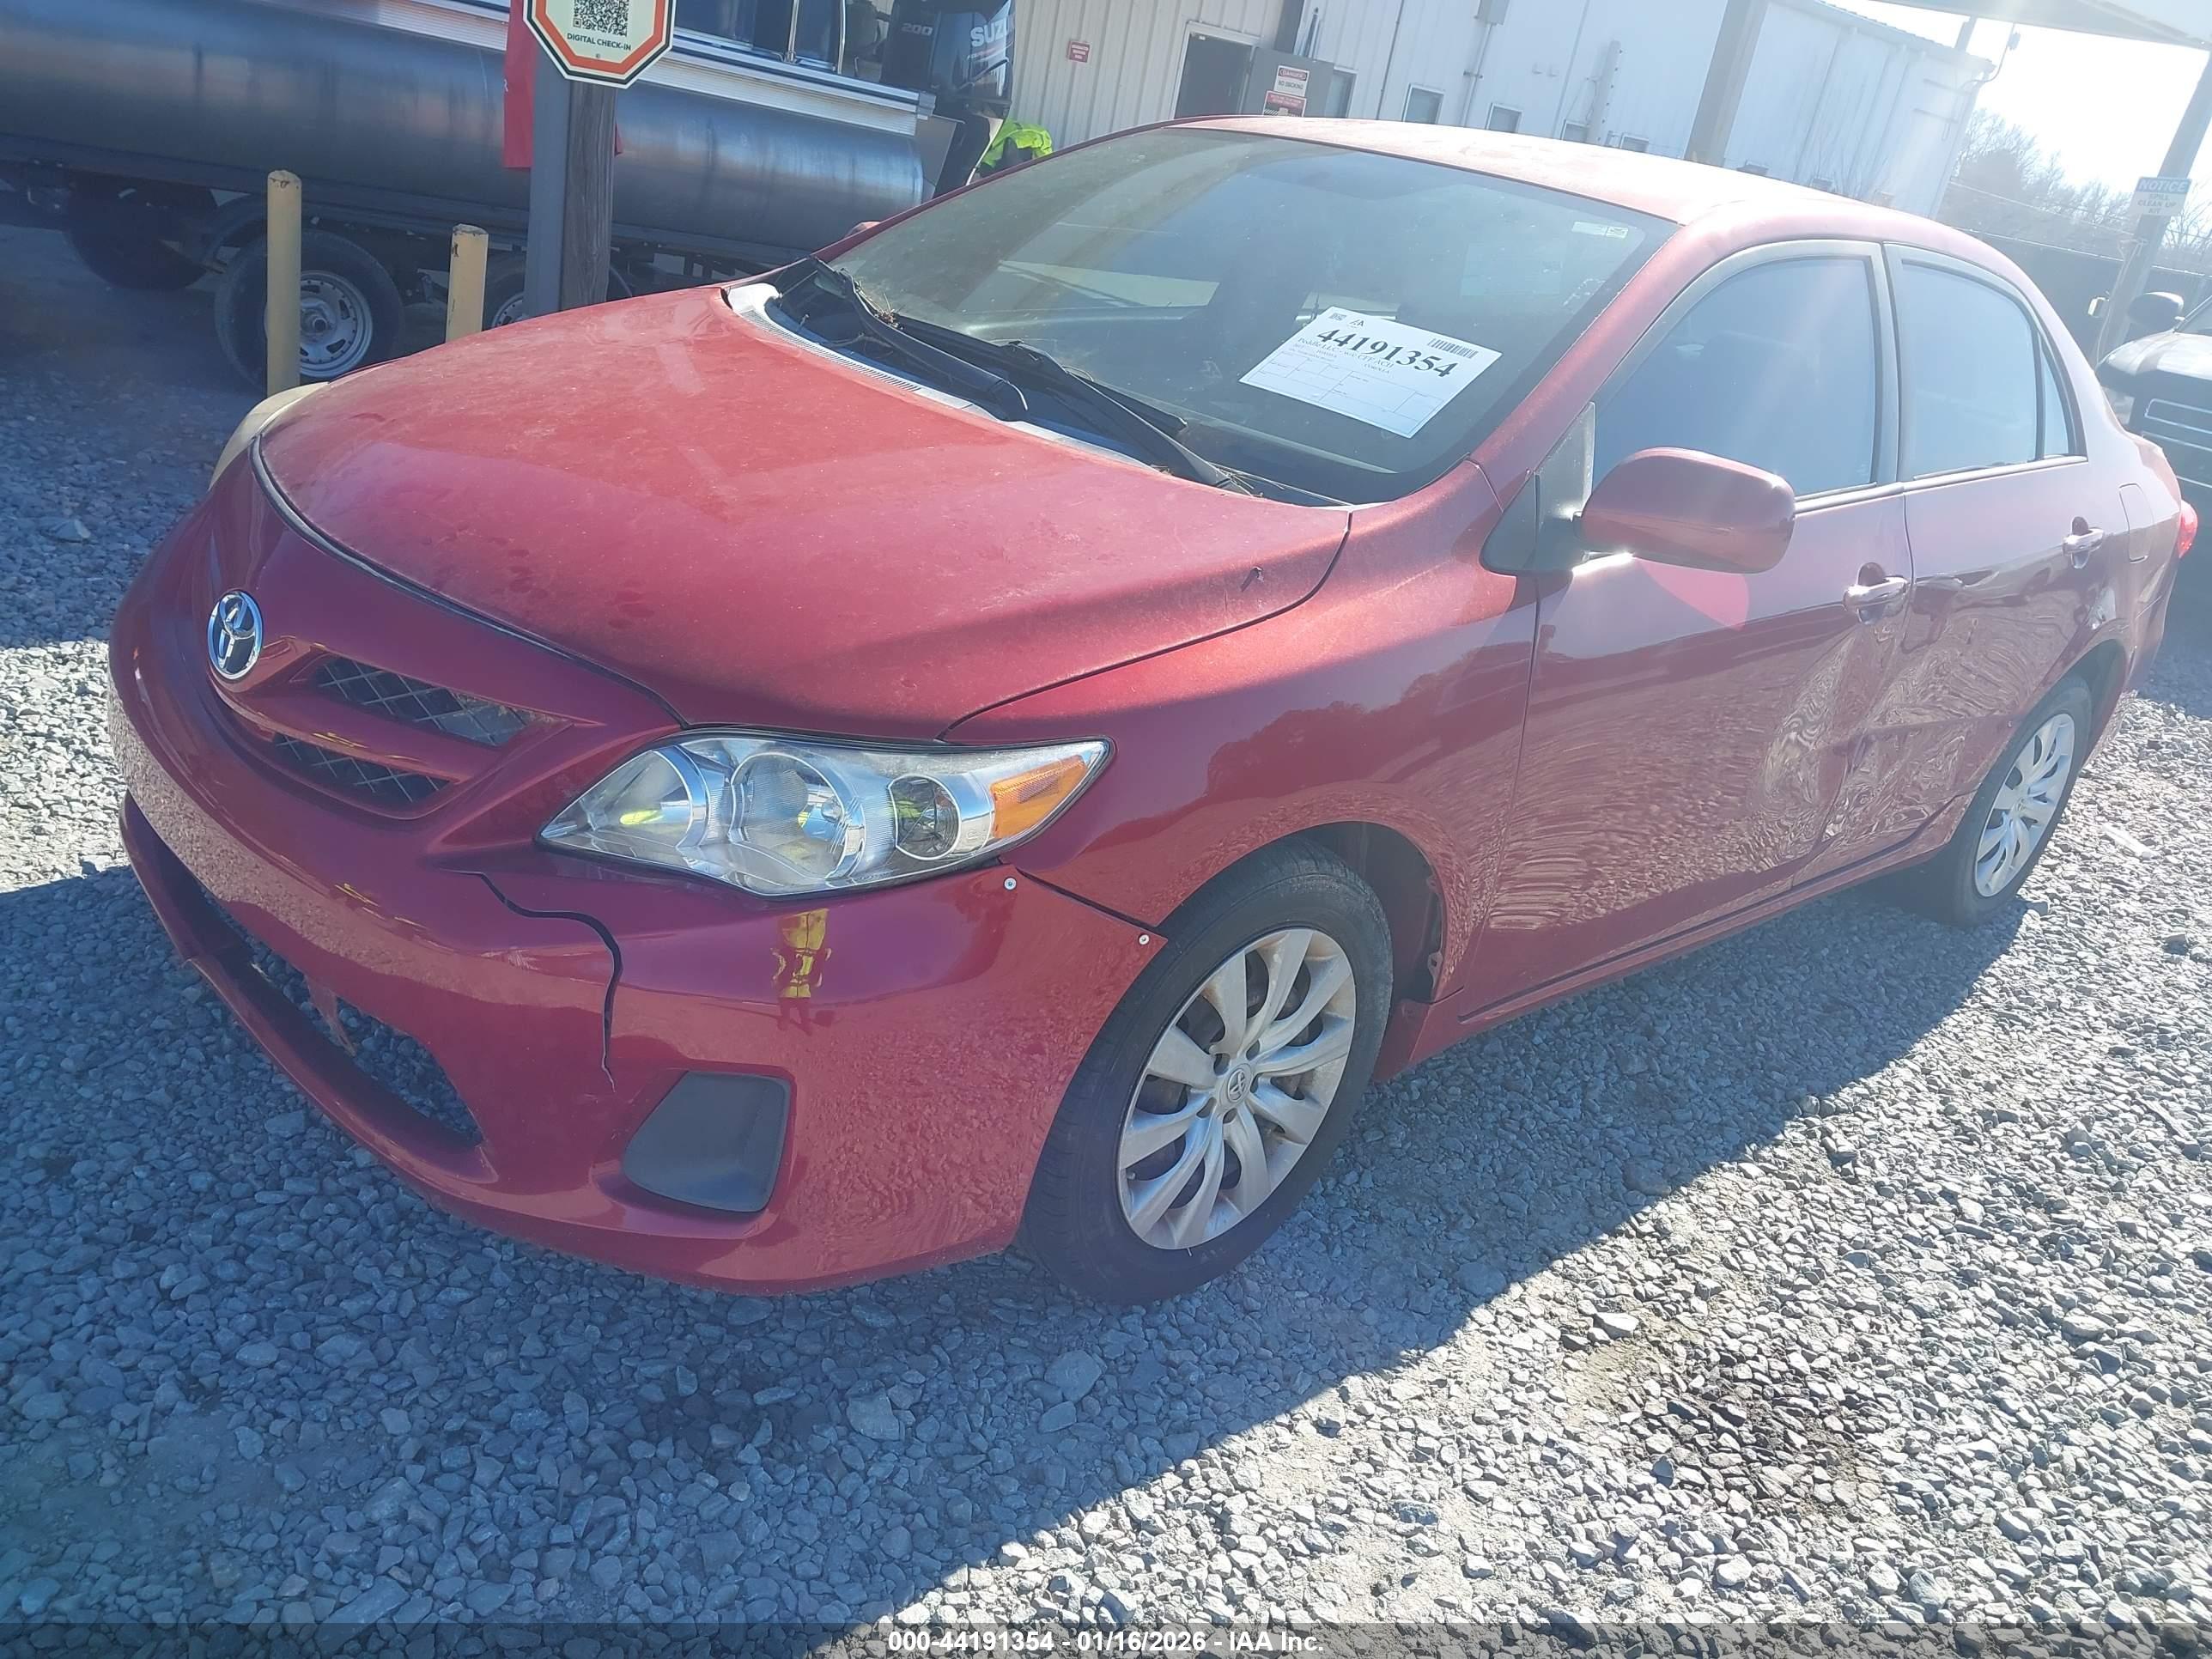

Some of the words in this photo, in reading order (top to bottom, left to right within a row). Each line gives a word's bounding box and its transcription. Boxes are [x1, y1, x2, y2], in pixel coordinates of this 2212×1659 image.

[902, 22, 933, 36] 200
[567, 33, 596, 45] DIGITAL
[597, 38, 631, 52] CHECK-IN
[2137, 179, 2188, 192] NOTICE
[1316, 329, 1458, 378] 44191354
